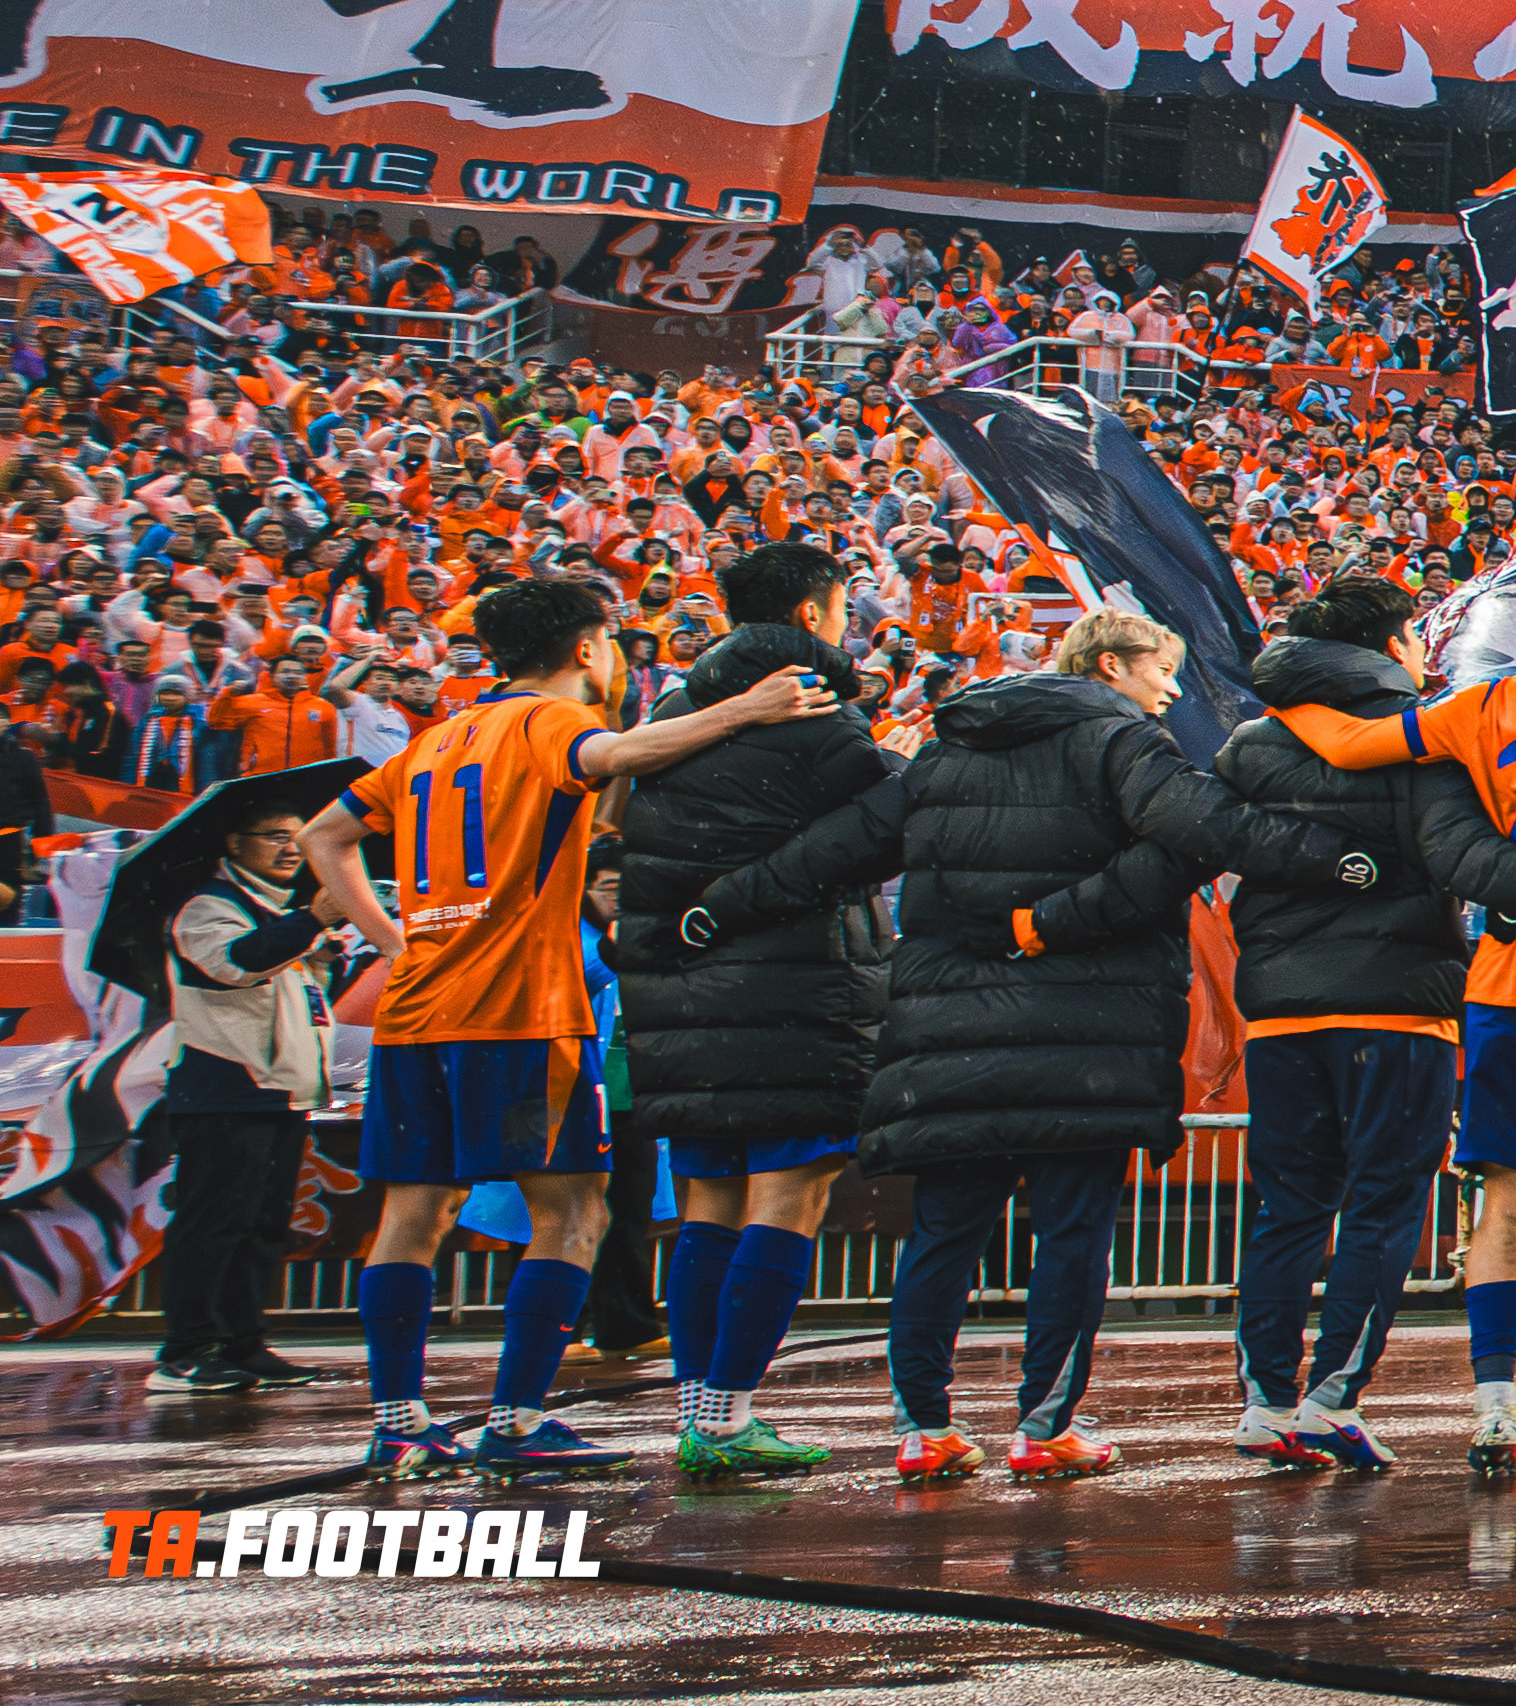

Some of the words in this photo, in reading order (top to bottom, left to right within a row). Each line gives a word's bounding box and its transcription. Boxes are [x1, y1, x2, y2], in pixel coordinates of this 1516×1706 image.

[88, 106, 201, 170] IN
[230, 138, 438, 194] THE
[461, 157, 782, 225] WORLD
[410, 763, 488, 894] 11
